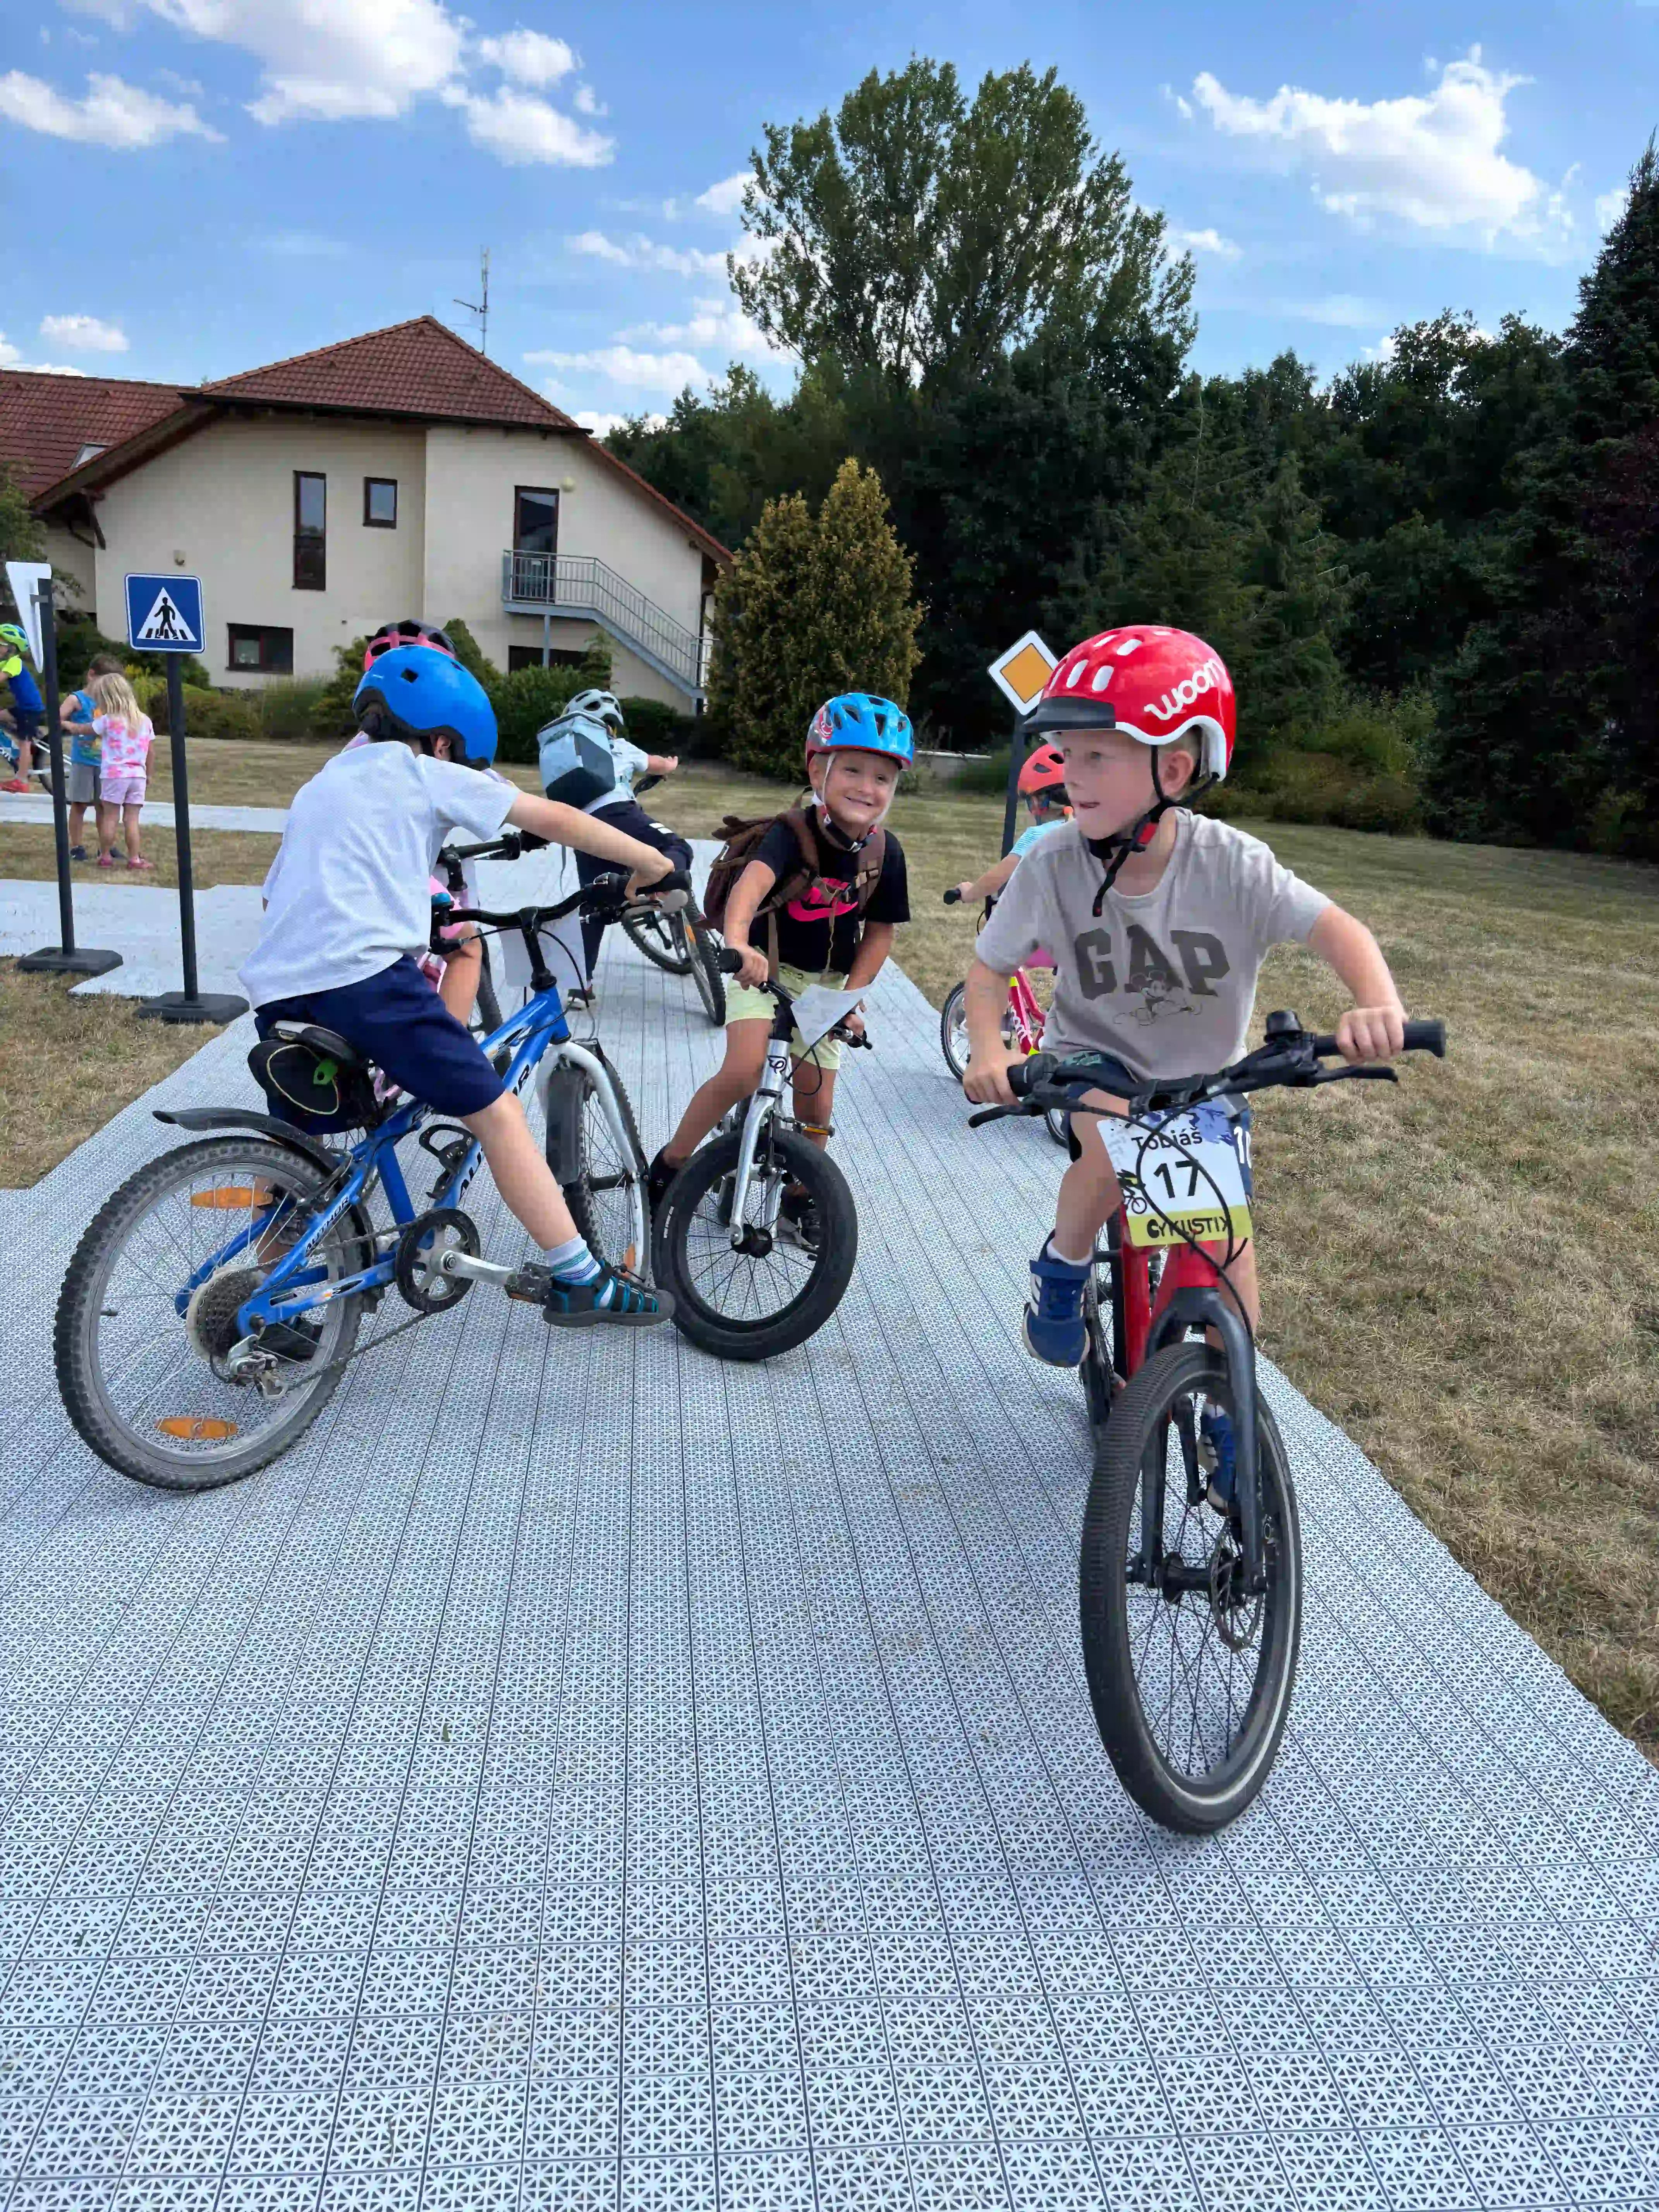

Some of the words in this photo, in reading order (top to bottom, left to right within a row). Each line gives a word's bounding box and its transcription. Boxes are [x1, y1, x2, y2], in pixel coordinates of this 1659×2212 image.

[1144, 658, 1228, 720] woom
[1075, 924, 1230, 1000] GAP
[1131, 1127, 1202, 1151] Tobiáš
[1153, 1160, 1199, 1198] 17
[306, 1196, 349, 1254] AUTHOR
